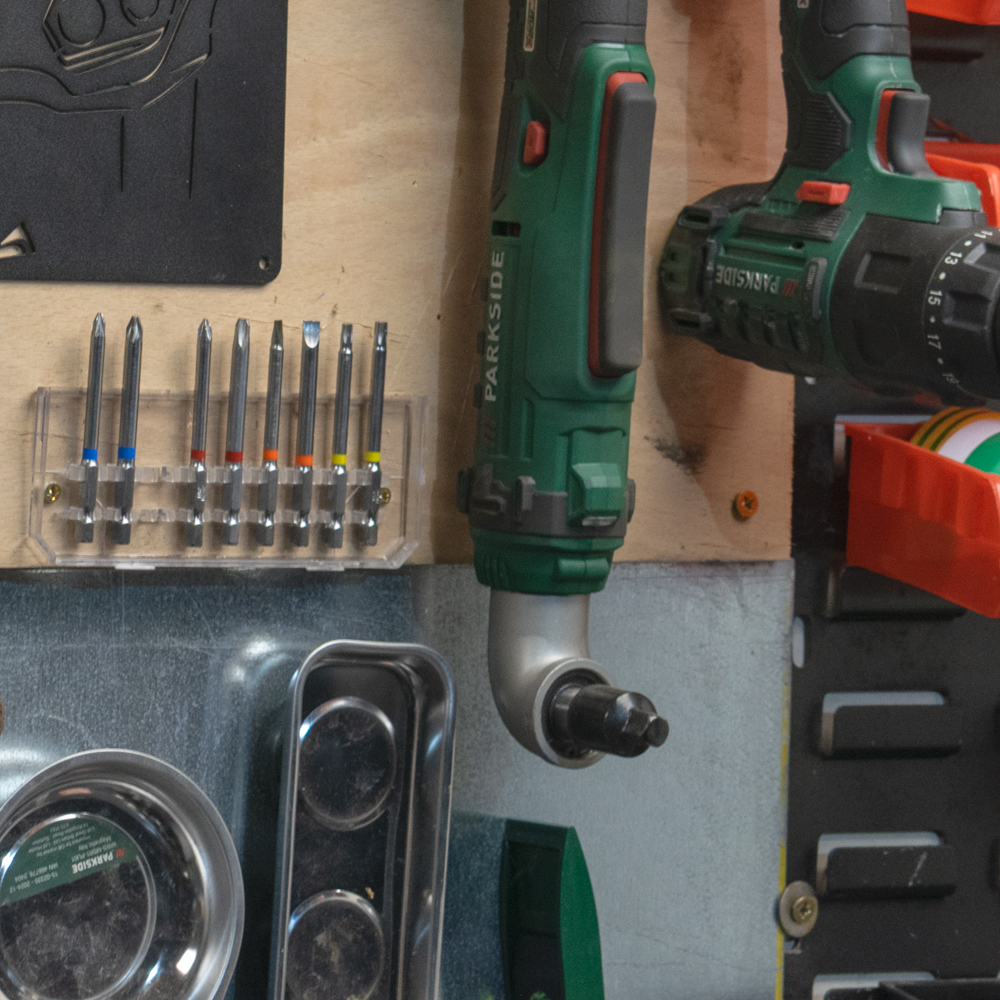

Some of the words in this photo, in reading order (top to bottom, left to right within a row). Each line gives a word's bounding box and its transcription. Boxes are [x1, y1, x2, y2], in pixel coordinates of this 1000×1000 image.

[944, 251, 963, 265] 13
[716, 265, 781, 295] PARKSIDE
[928, 290, 943, 306] 15
[484, 252, 505, 402] PARKSIDE
[927, 334, 942, 350] 17
[72, 851, 114, 874] PARKSIDE
